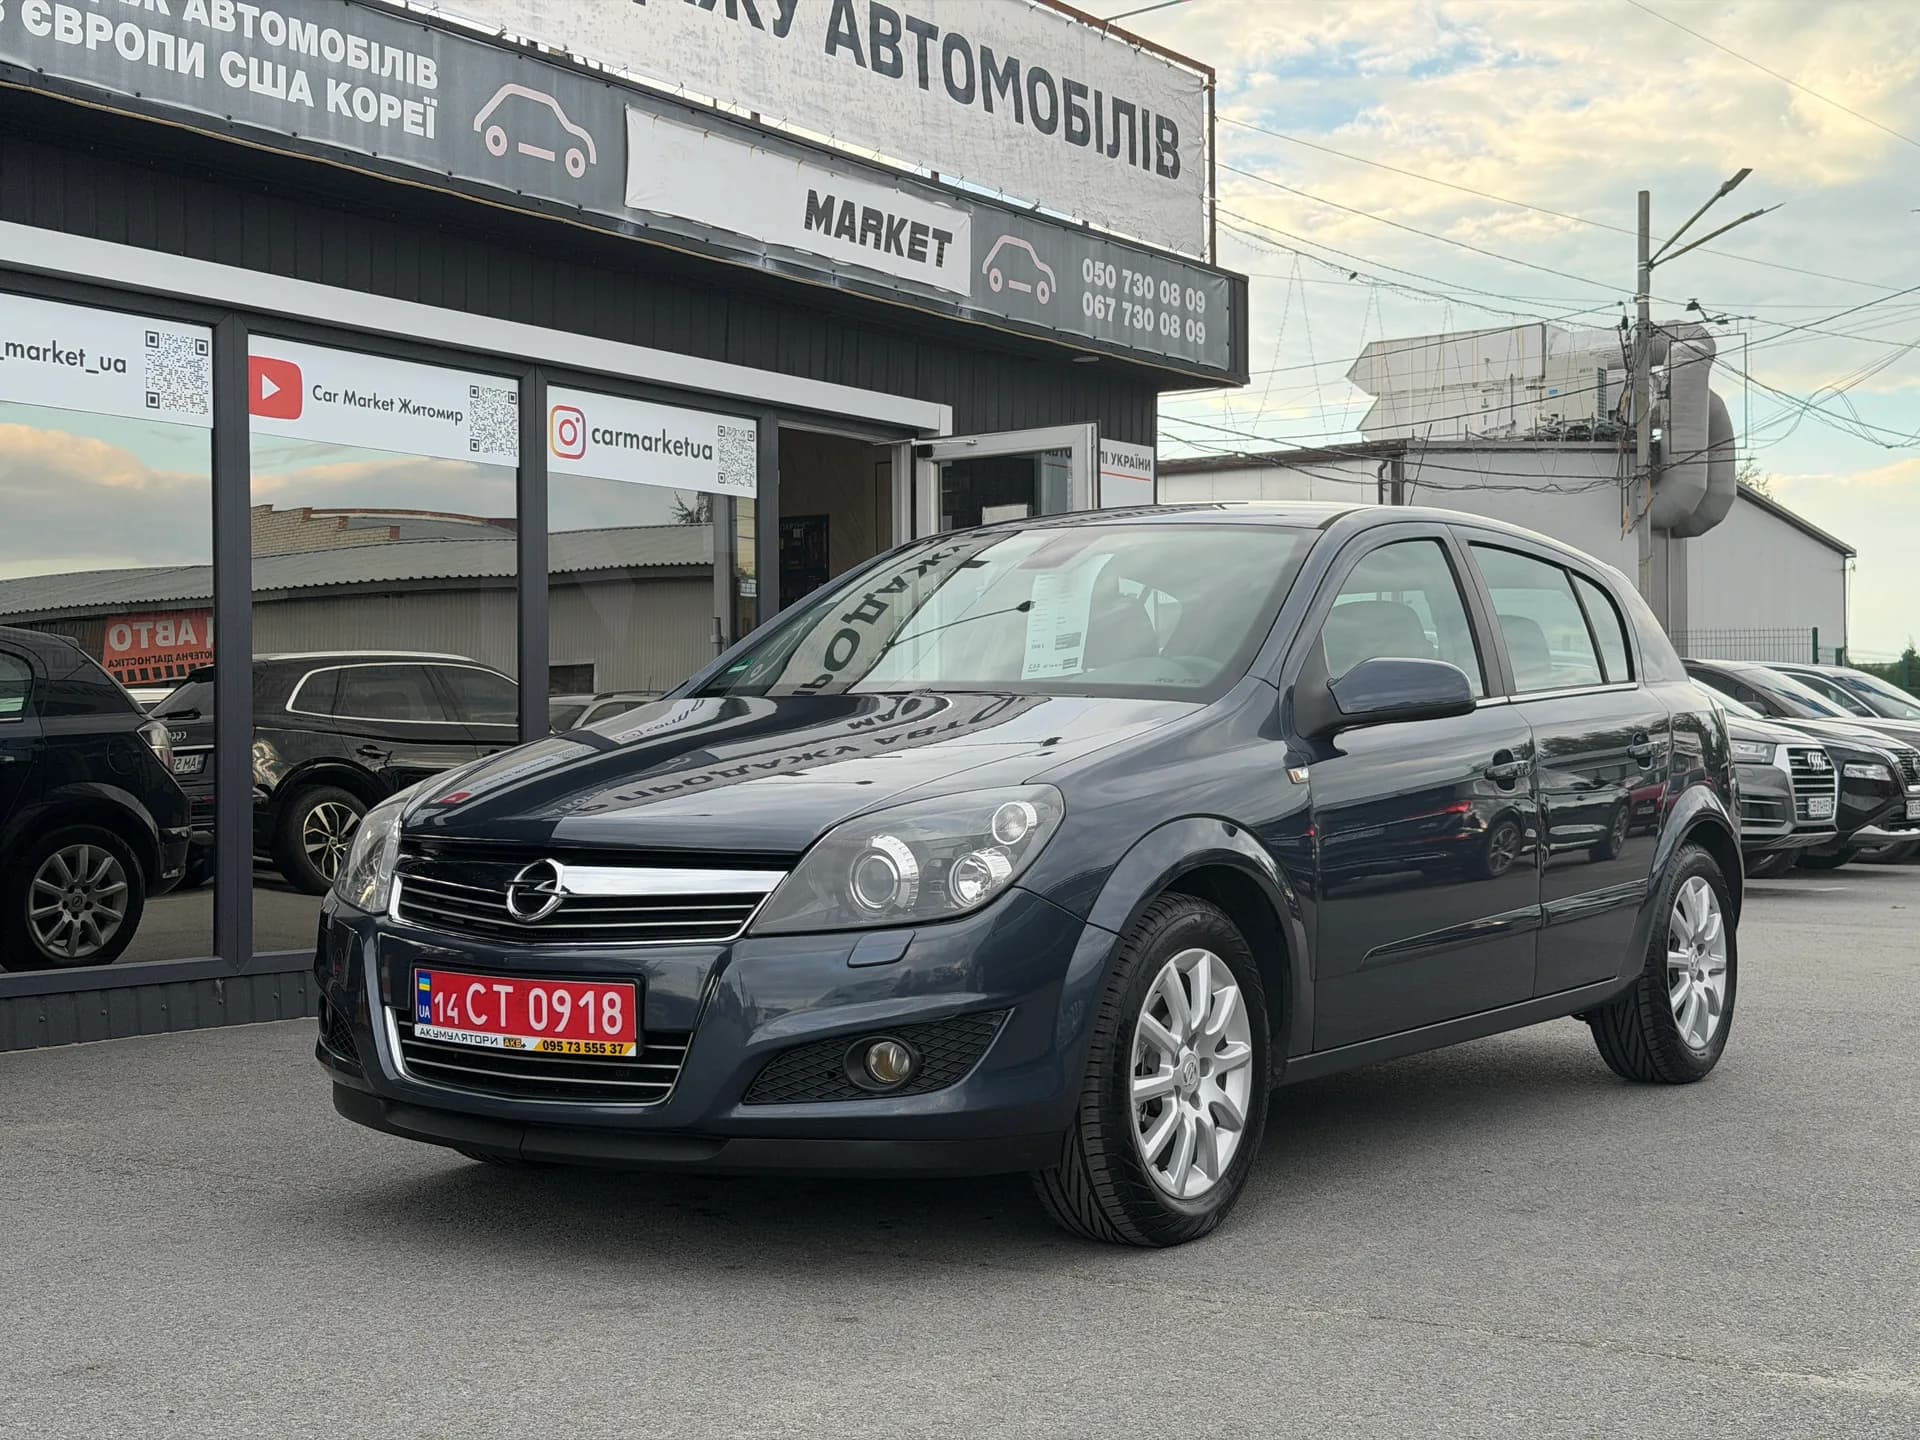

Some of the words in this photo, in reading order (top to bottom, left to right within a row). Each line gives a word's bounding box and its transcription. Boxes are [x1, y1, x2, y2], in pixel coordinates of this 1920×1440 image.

[183, 0, 438, 90] АВТОМОБІЛІВ
[21, 0, 205, 79] ЄВРОПИ
[219, 51, 315, 107] США
[326, 78, 438, 139] КОРЕЇ
[825, 0, 1182, 180] АВТОМОБІЛІВ
[804, 189, 953, 268] MARKET
[1082, 258, 1117, 289] 050
[1121, 269, 1155, 300] 730
[1159, 280, 1181, 307] 08
[1185, 287, 1206, 314] 09
[1082, 291, 1117, 322] 067
[1121, 301, 1155, 332] 730
[1159, 312, 1181, 338] 08
[1185, 318, 1206, 345] 09
[312, 384, 339, 404] Car
[343, 389, 395, 412] Market
[398, 397, 464, 426] Житомир
[591, 428, 713, 461] carmarketua
[1111, 452, 1151, 472] УКРАЇНИ
[419, 1003, 431, 1019] UA
[528, 987, 623, 1035] 0918
[419, 1027, 499, 1046] АКУМУЛЯТОРИ
[542, 1040, 564, 1052] 095
[567, 1041, 581, 1053] 73
[584, 1042, 607, 1054] 555
[609, 1043, 624, 1055] 37
